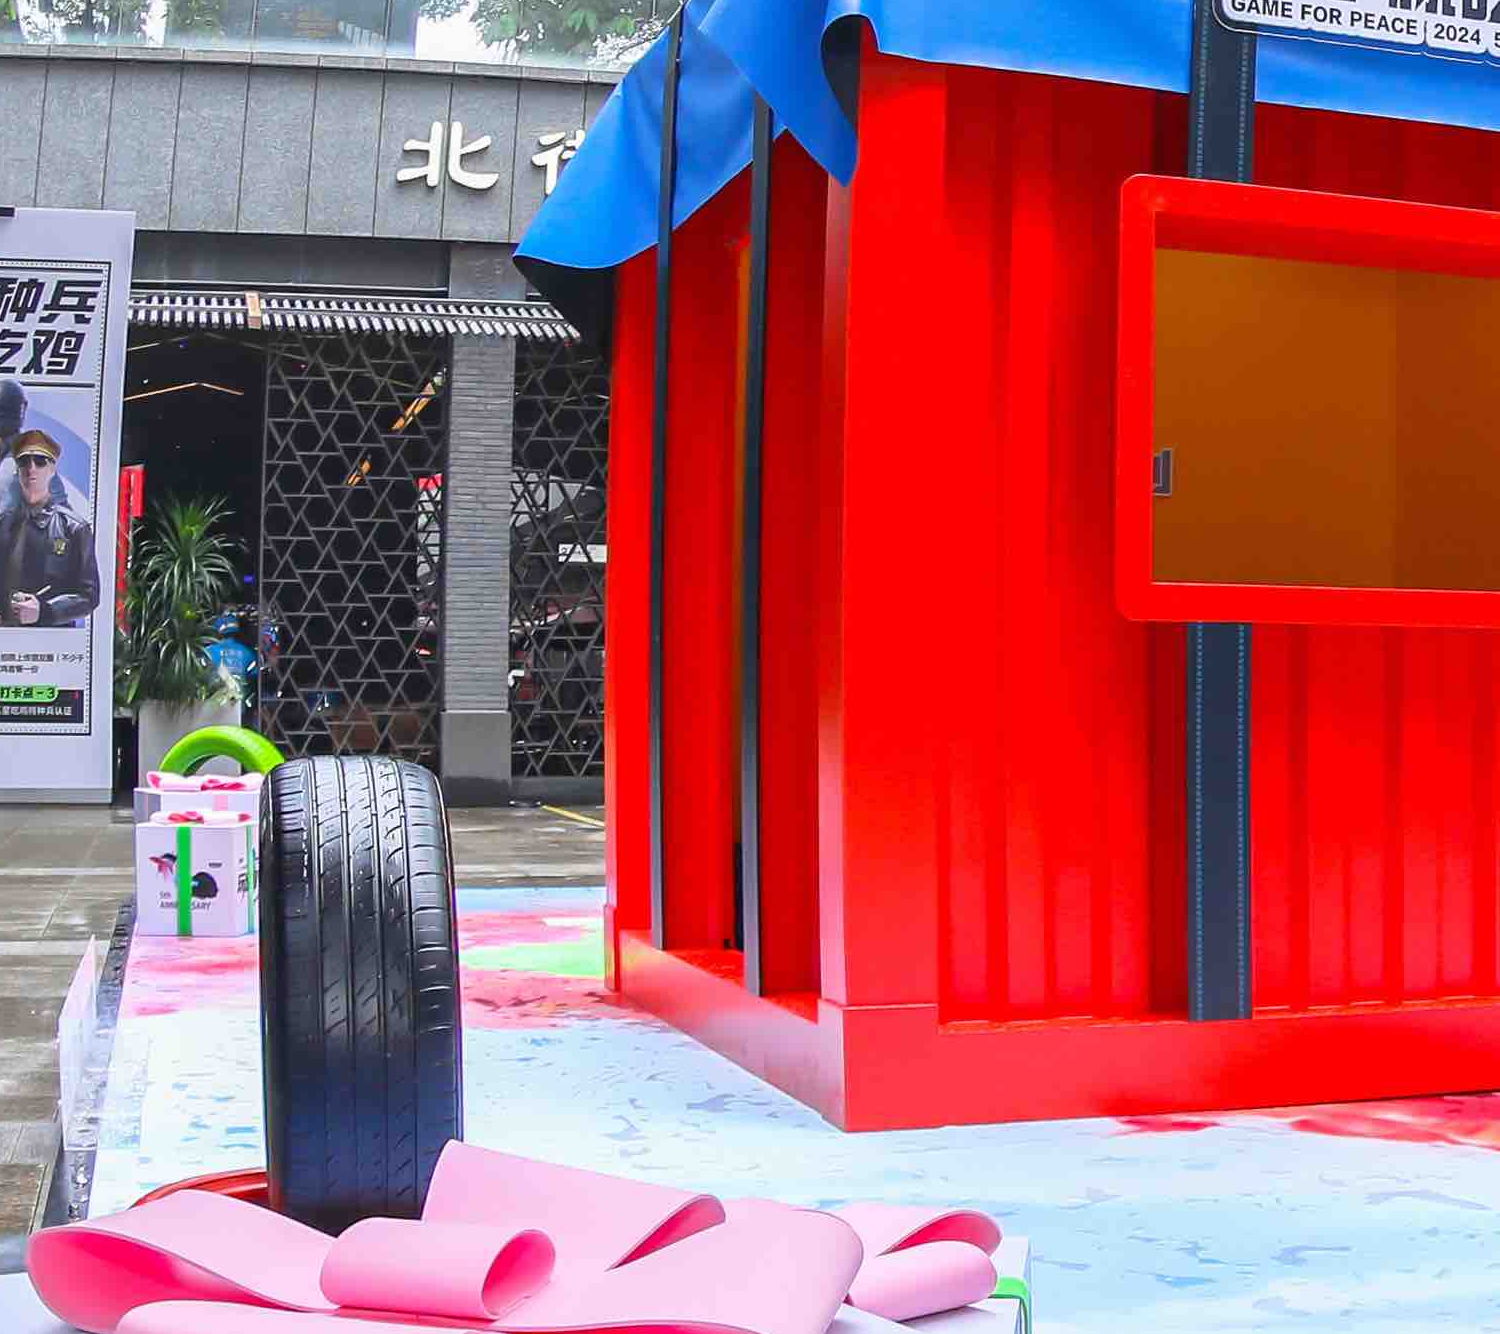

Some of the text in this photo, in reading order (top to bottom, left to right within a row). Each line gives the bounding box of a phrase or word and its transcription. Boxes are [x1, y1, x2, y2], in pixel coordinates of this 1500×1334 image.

[1300, 3, 1343, 27] FOR
[1349, 10, 1419, 38] PEACE
[1433, 20, 1483, 47] 2024
